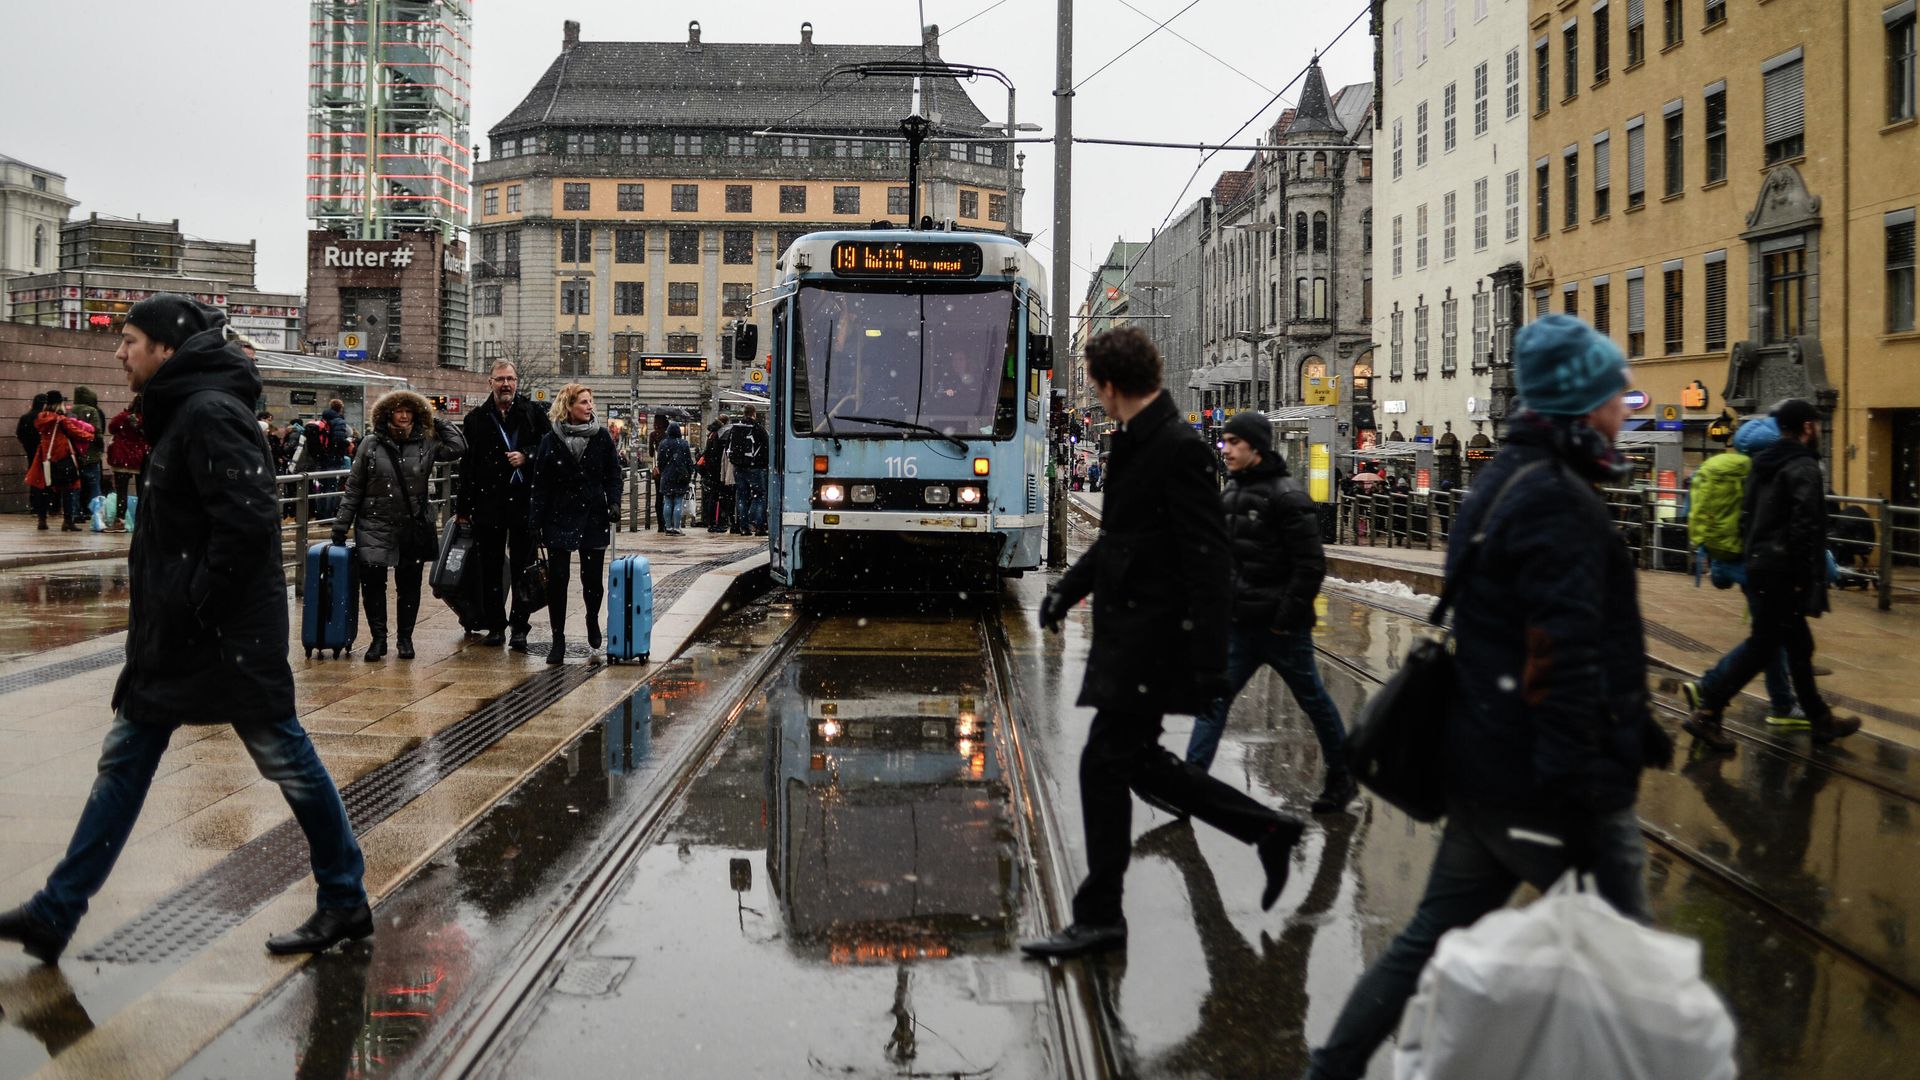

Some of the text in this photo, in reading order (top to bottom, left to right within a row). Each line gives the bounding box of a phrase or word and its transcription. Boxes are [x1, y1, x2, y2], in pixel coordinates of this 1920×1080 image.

[324, 246, 414, 267] Ruter#
[255, 335, 280, 345] Kebab
[884, 456, 918, 478] 116
